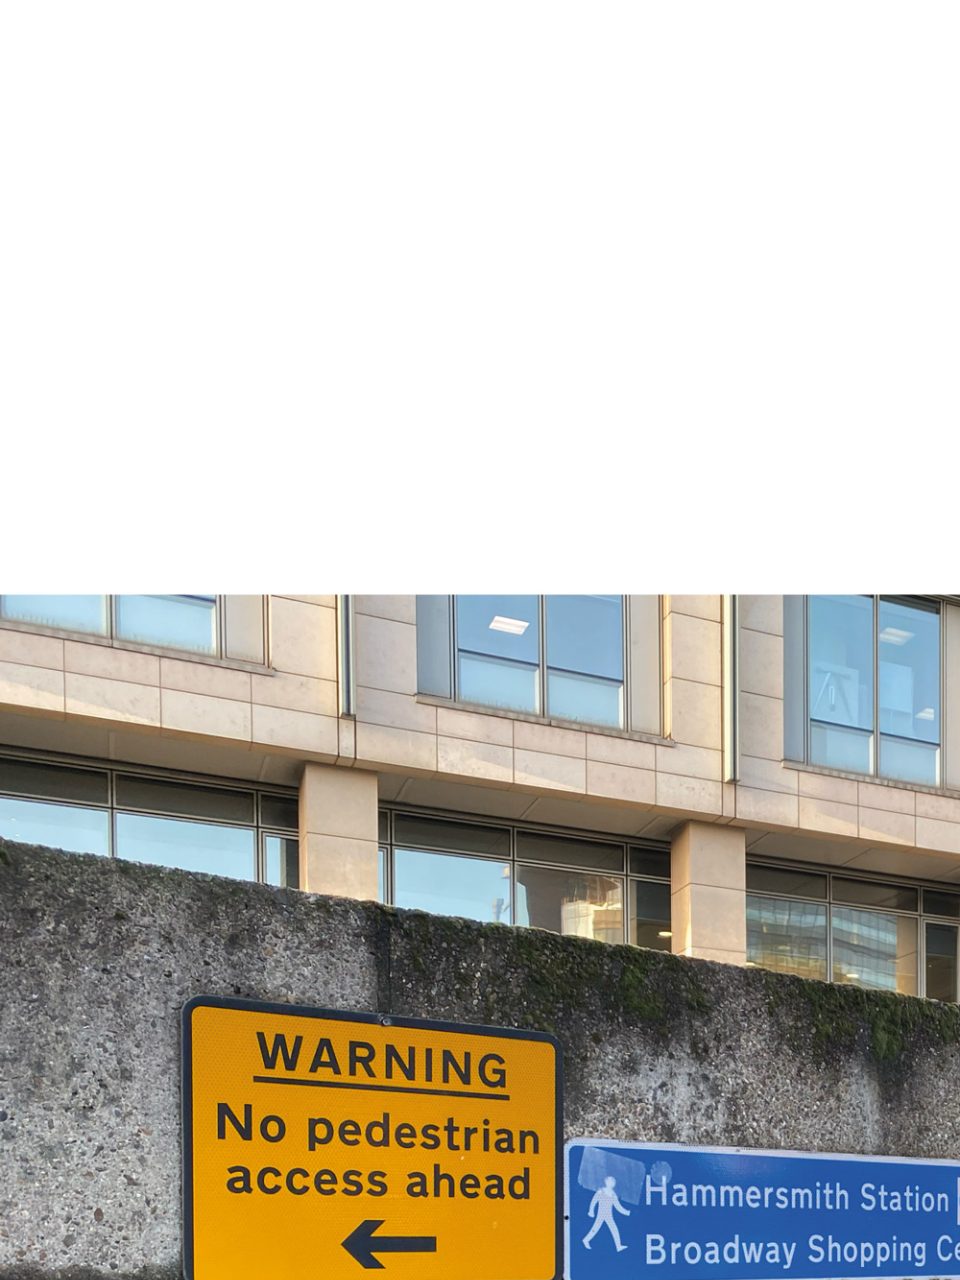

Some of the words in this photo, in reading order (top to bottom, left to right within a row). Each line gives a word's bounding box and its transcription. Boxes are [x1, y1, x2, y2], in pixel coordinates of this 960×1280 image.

[256, 1031, 506, 1088] WARNING
[216, 1102, 286, 1143] No
[308, 1112, 540, 1154] pedestrian
[227, 1164, 388, 1196] access
[406, 1163, 531, 1200] ahead
[645, 1175, 849, 1211] Hammersmith
[860, 1183, 949, 1213] Station
[646, 1234, 797, 1270] Broadway
[808, 1235, 927, 1268] Shopping
